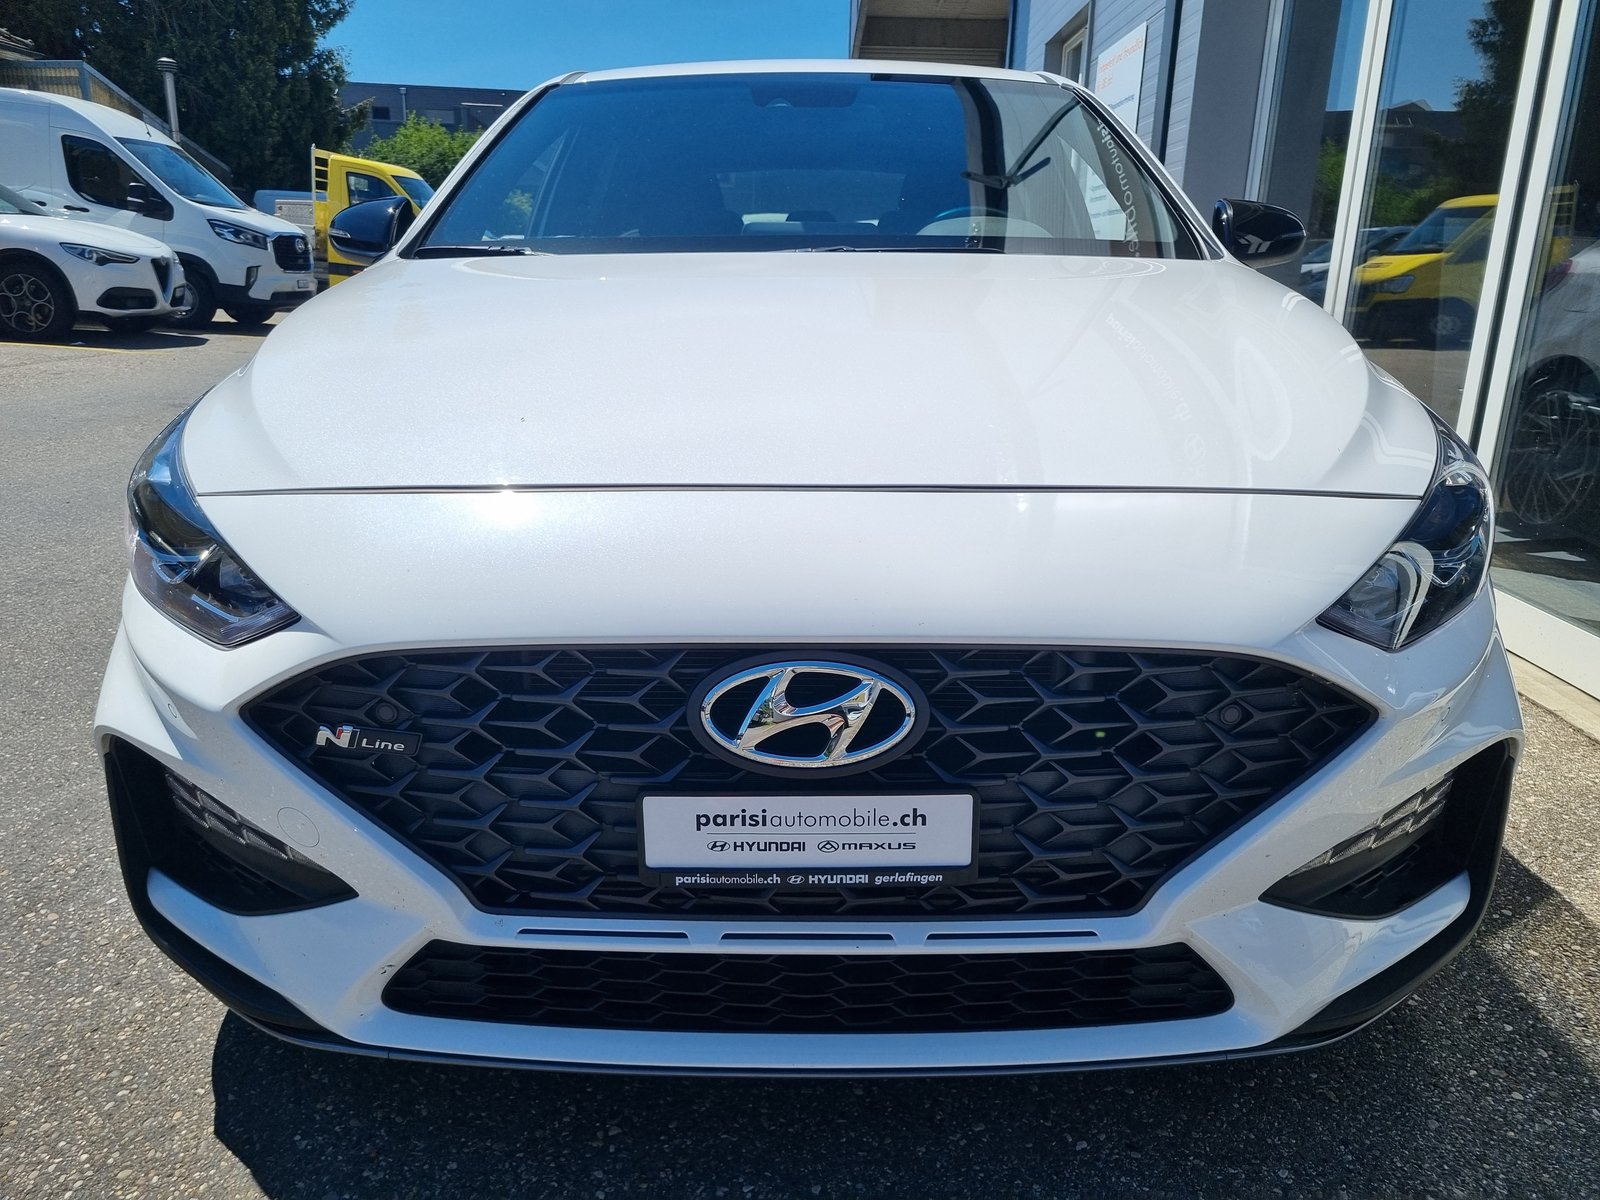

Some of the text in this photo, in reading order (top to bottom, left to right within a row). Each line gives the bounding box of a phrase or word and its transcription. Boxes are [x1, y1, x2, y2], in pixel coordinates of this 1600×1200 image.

[316, 725, 405, 751] N Line
[696, 807, 927, 832] parisiautomobile.ch
[733, 841, 917, 852] HYUNDAI MAXUS
[675, 872, 943, 885] parisiautomobile.ch HYUNDAI gerlafingen
